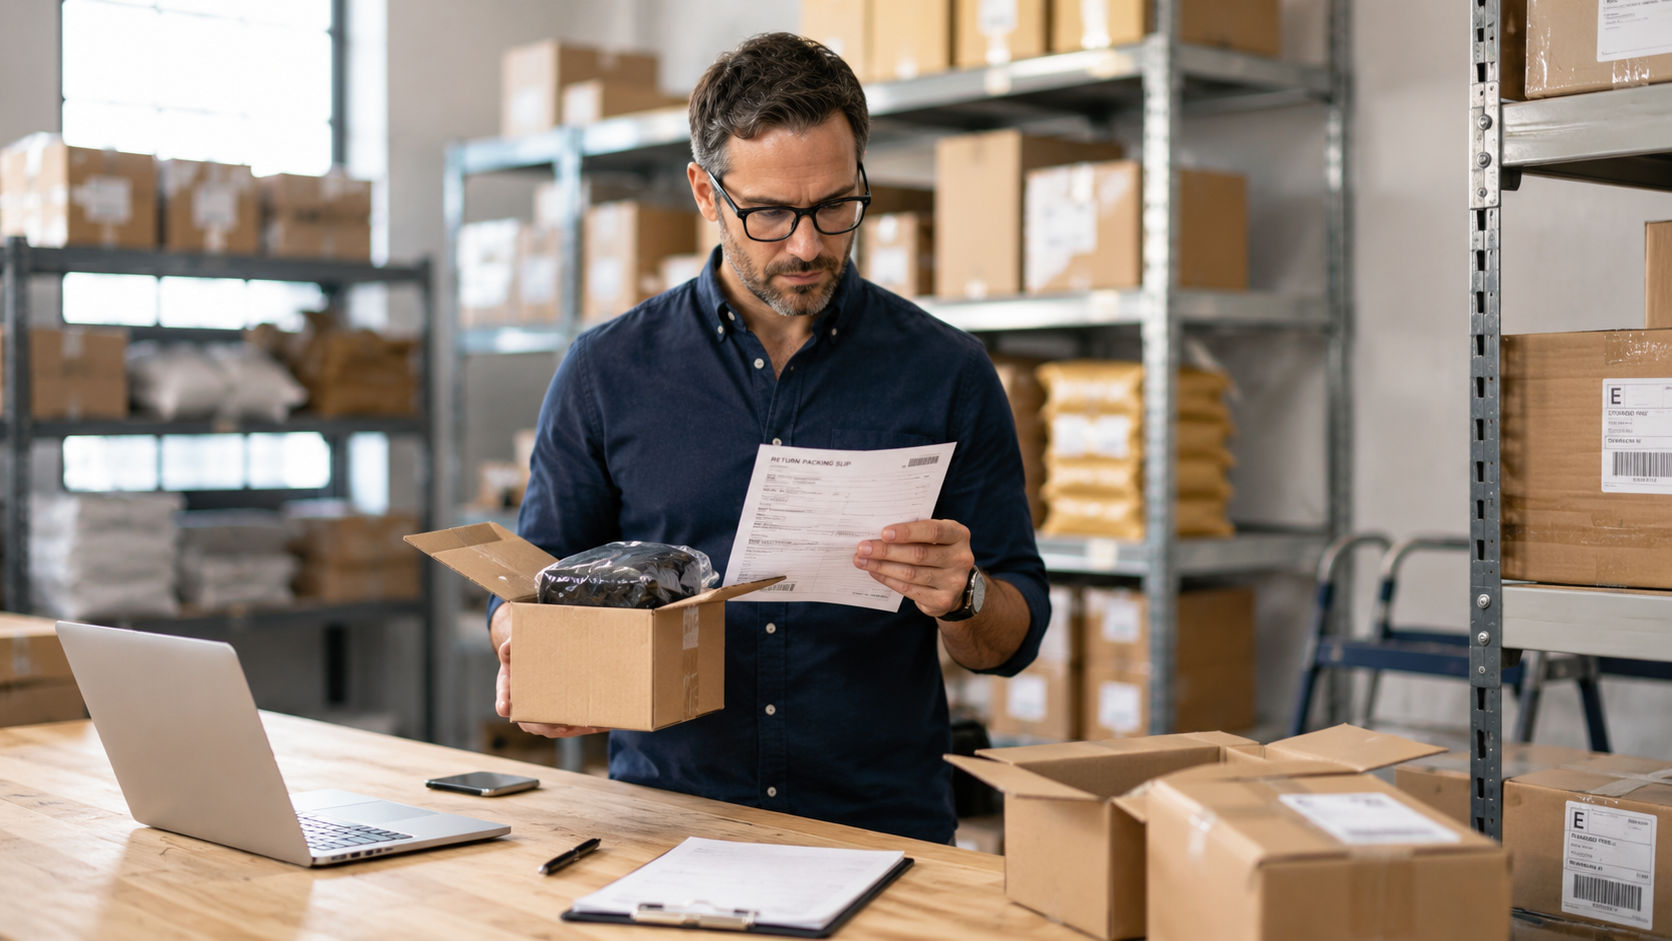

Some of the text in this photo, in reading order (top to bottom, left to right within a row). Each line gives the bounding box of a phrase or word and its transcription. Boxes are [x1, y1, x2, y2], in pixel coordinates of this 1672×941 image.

[1611, 387, 1621, 404] E
[770, 456, 801, 464] RETURN
[1573, 811, 1584, 829] E
